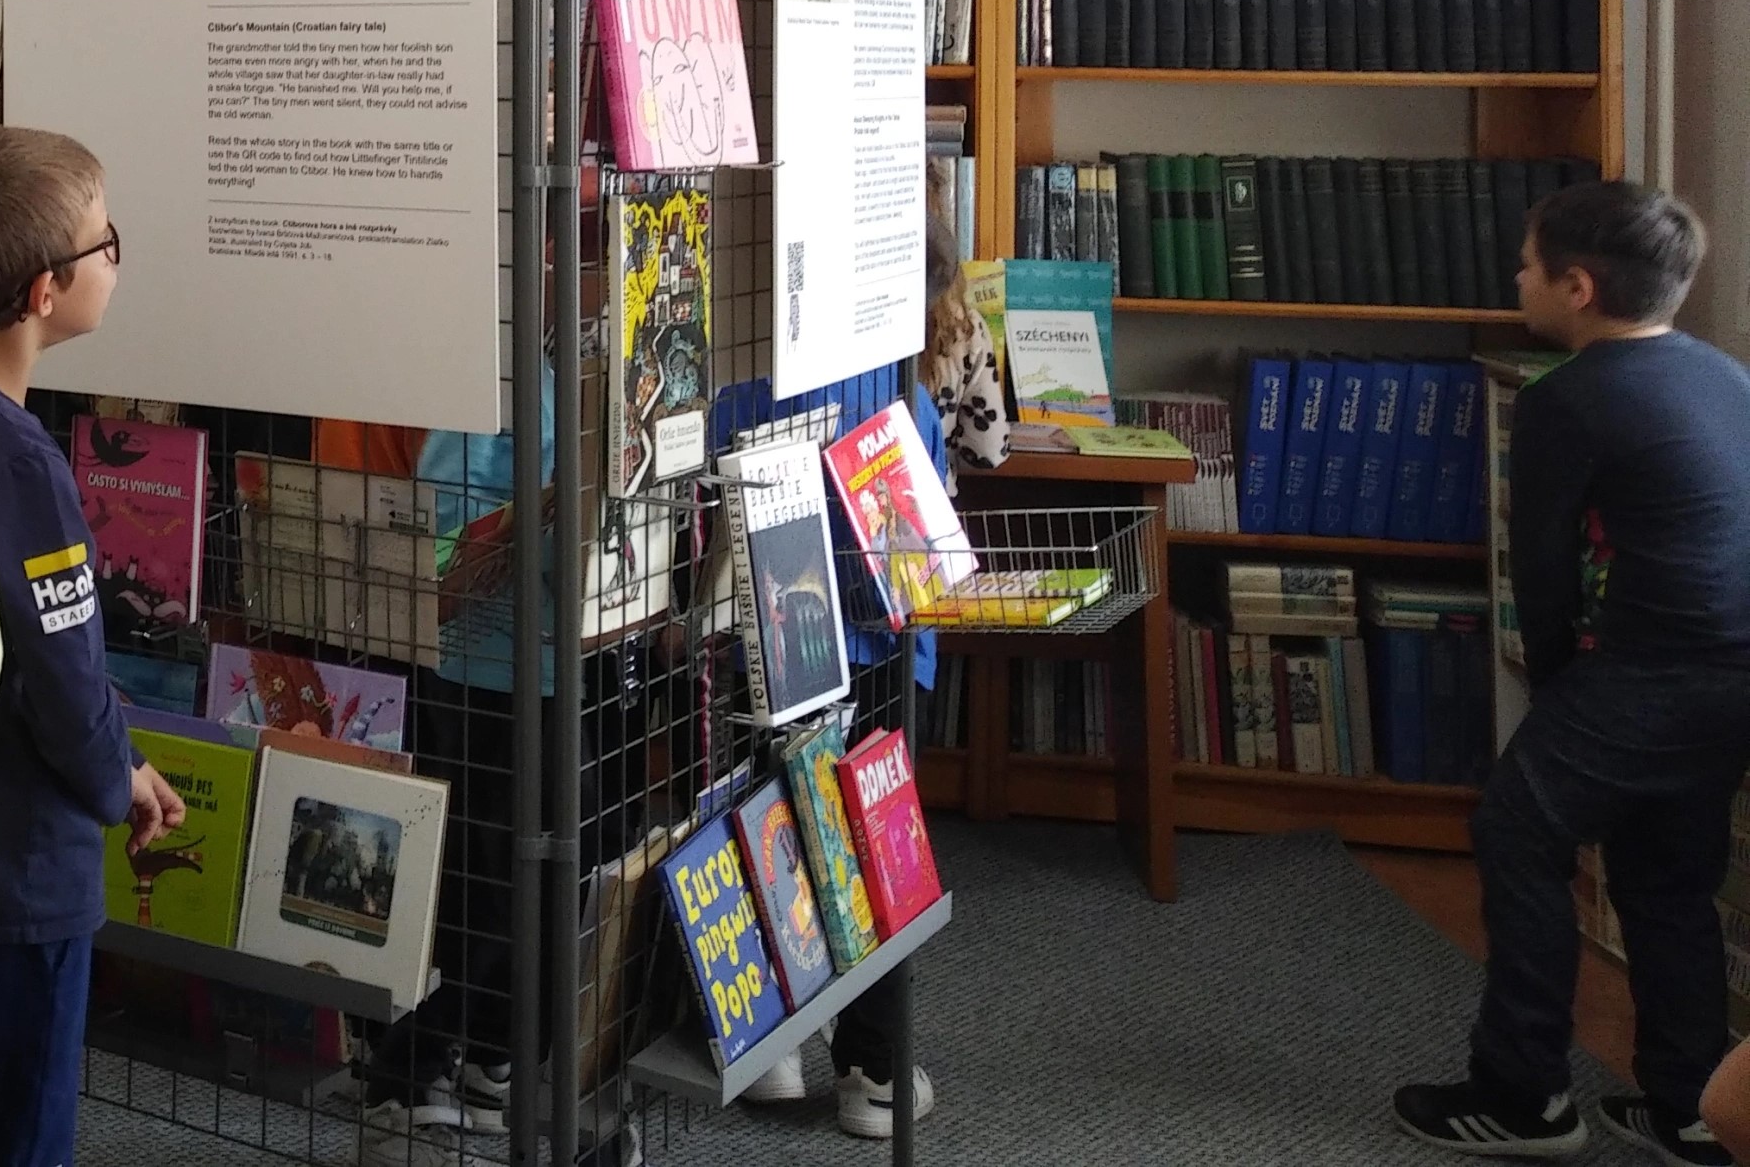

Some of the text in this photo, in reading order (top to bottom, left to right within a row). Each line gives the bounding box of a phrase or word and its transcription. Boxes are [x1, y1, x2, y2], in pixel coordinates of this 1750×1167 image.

[246, 21, 289, 33] Mountain
[292, 21, 337, 34] (Croatian
[339, 21, 361, 34] fairy
[364, 21, 386, 34] tale)
[207, 42, 453, 55] The grandmother told the tiny men how her foolish son
[207, 56, 242, 67] became
[244, 58, 266, 67] even
[268, 58, 291, 67] more
[293, 56, 319, 68] angry
[321, 56, 340, 67] with
[362, 56, 388, 67] when
[390, 56, 403, 67] he
[405, 56, 424, 67] and
[426, 56, 442, 68] the
[208, 97, 224, 109] you
[253, 97, 269, 108] The
[271, 98, 288, 110] tiny
[289, 100, 310, 108] men
[312, 98, 334, 108] went
[366, 98, 386, 110] they
[388, 98, 415, 109] could
[417, 99, 433, 109] not
[435, 99, 467, 110] advise
[1015, 328, 1089, 343] SZÉCHENYI
[747, 641, 766, 710] POLSKIE
[711, 962, 762, 1038] Popo
